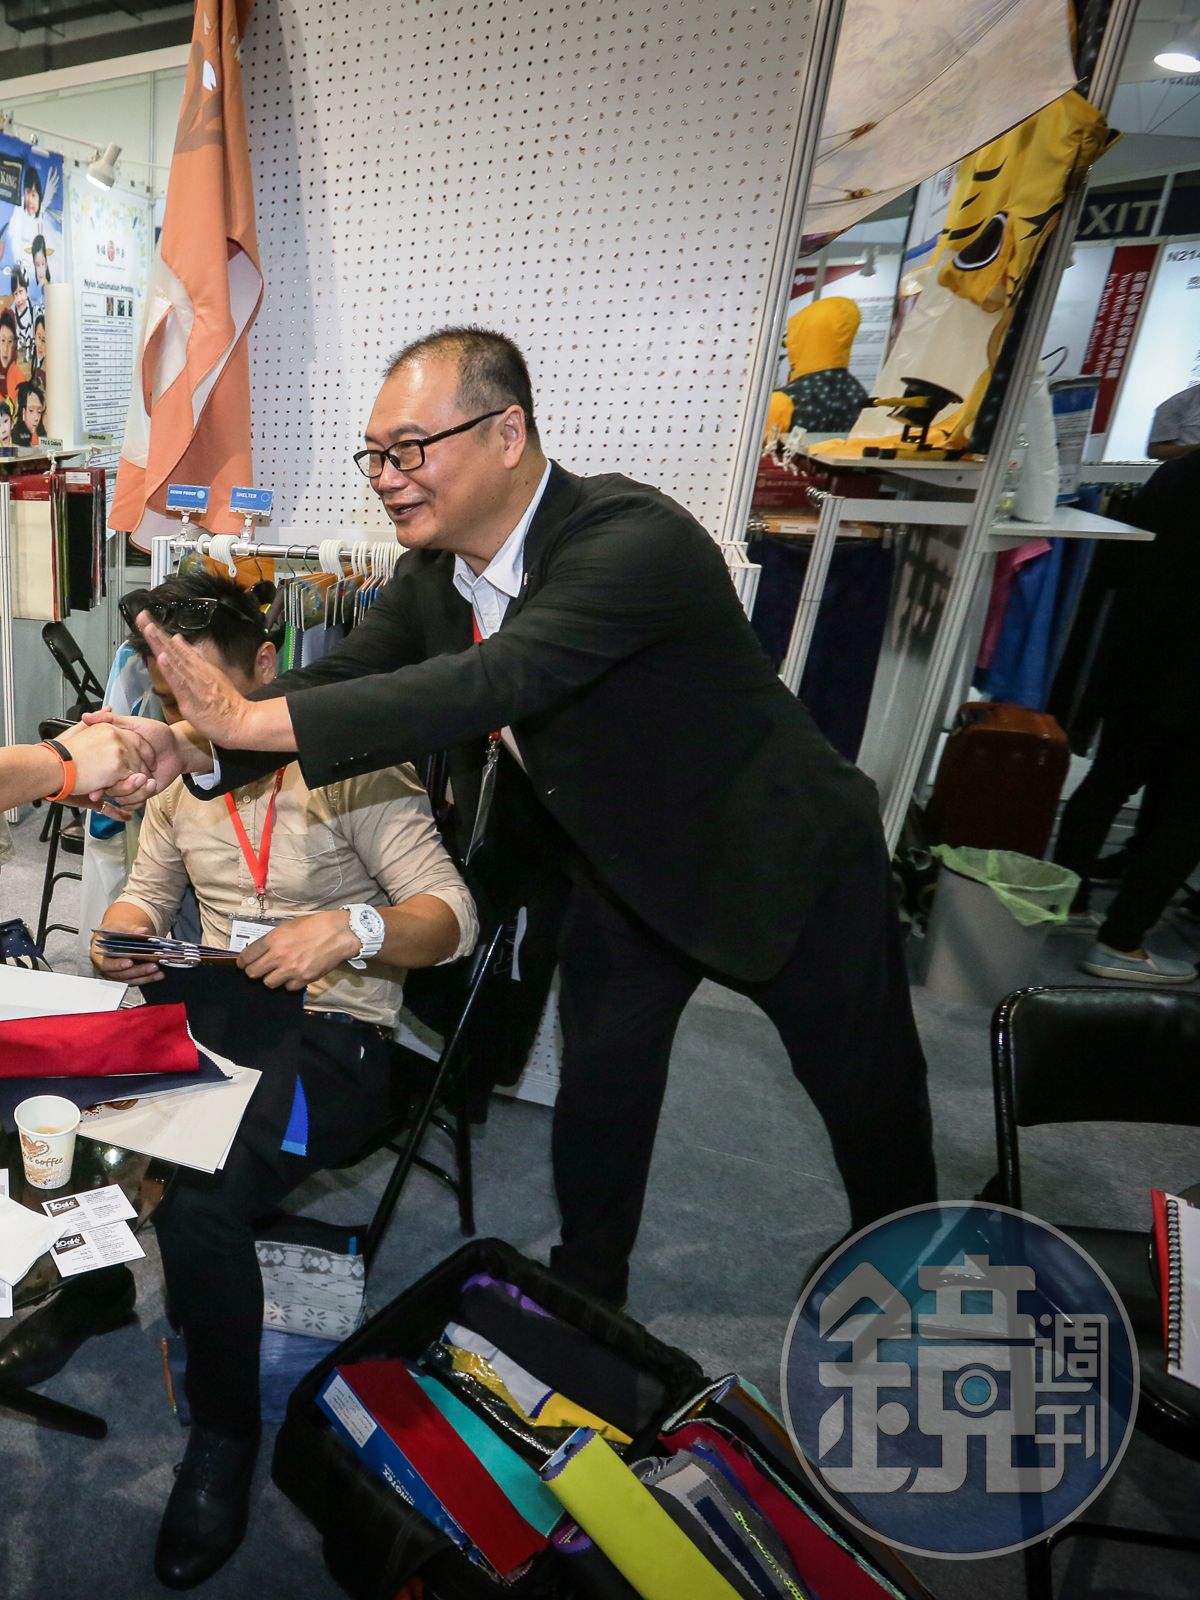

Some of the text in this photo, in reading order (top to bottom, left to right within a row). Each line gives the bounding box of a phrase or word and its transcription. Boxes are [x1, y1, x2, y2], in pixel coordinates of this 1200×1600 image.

[0, 171, 18, 188] KING
[1079, 200, 1161, 235] XIT
[35, 1157, 64, 1167] coffee
